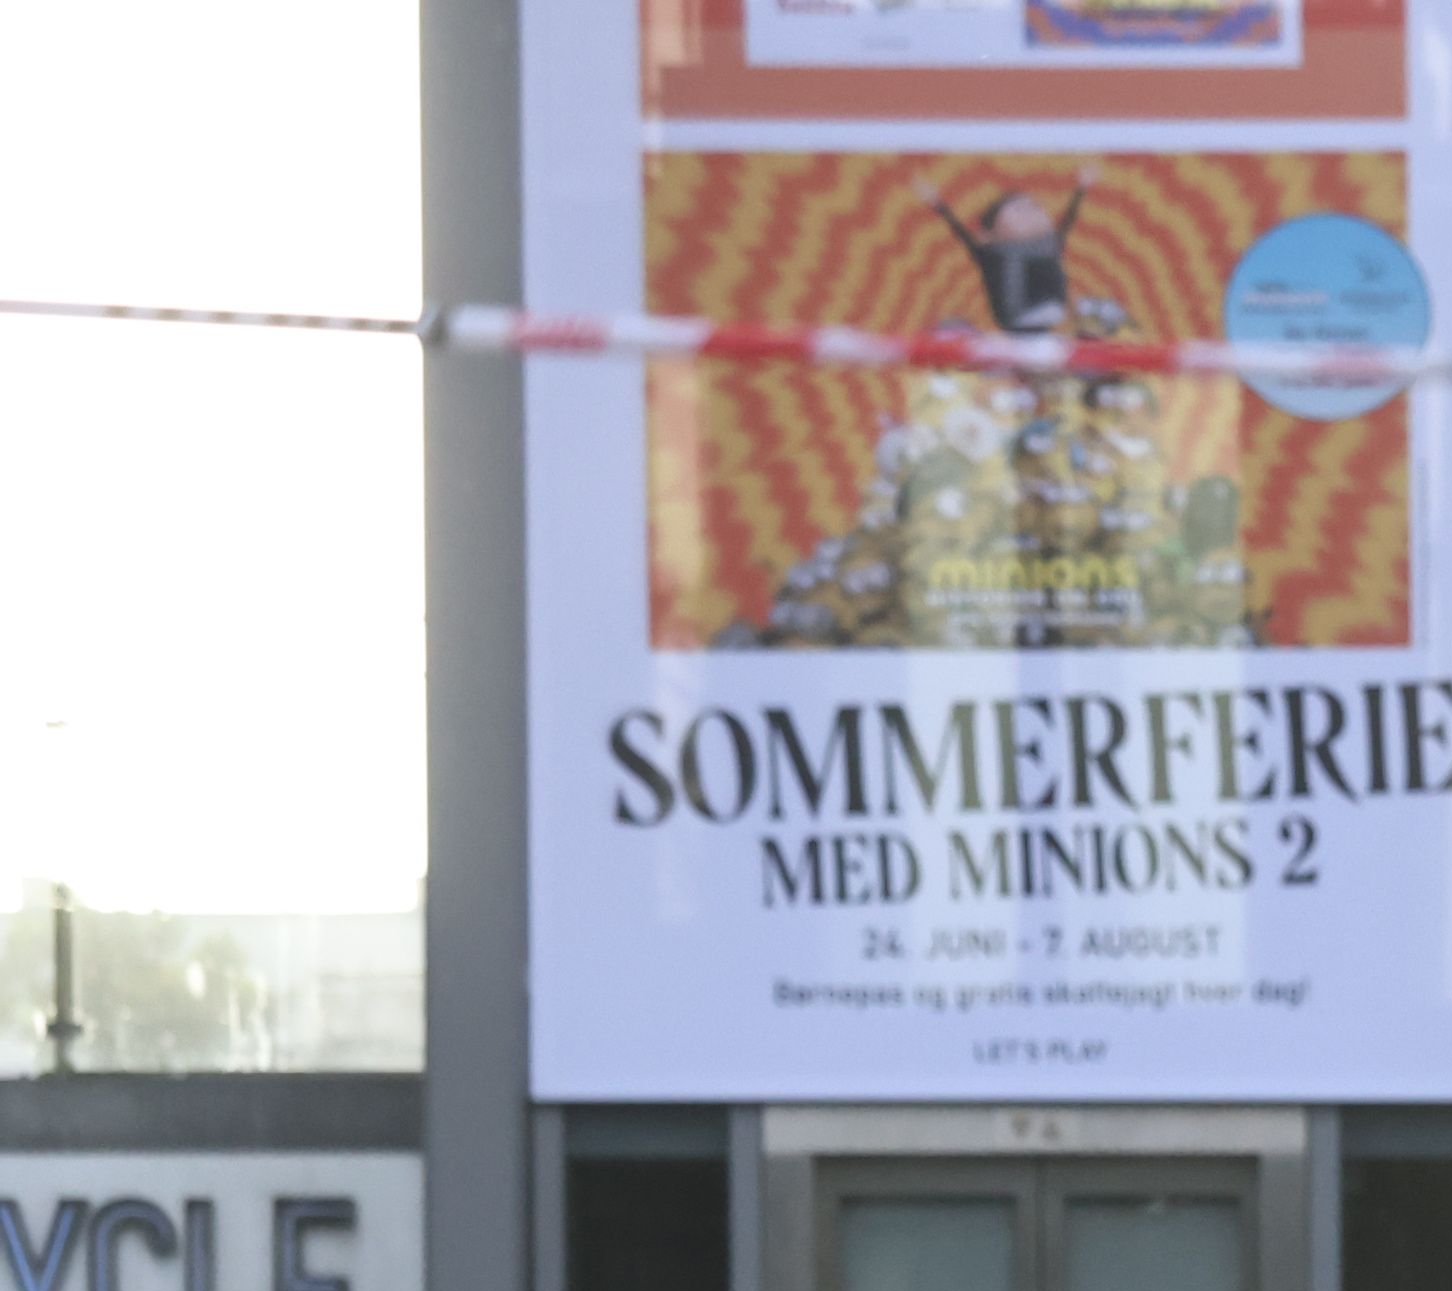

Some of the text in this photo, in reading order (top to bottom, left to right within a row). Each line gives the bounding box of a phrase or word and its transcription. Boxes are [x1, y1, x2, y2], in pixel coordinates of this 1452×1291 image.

[759, 816, 1320, 909] MED MINIONS 2
[924, 926, 1008, 960] JUNI
[1077, 924, 1221, 958] AUGUST
[1046, 1038, 1109, 1064] PLAY
